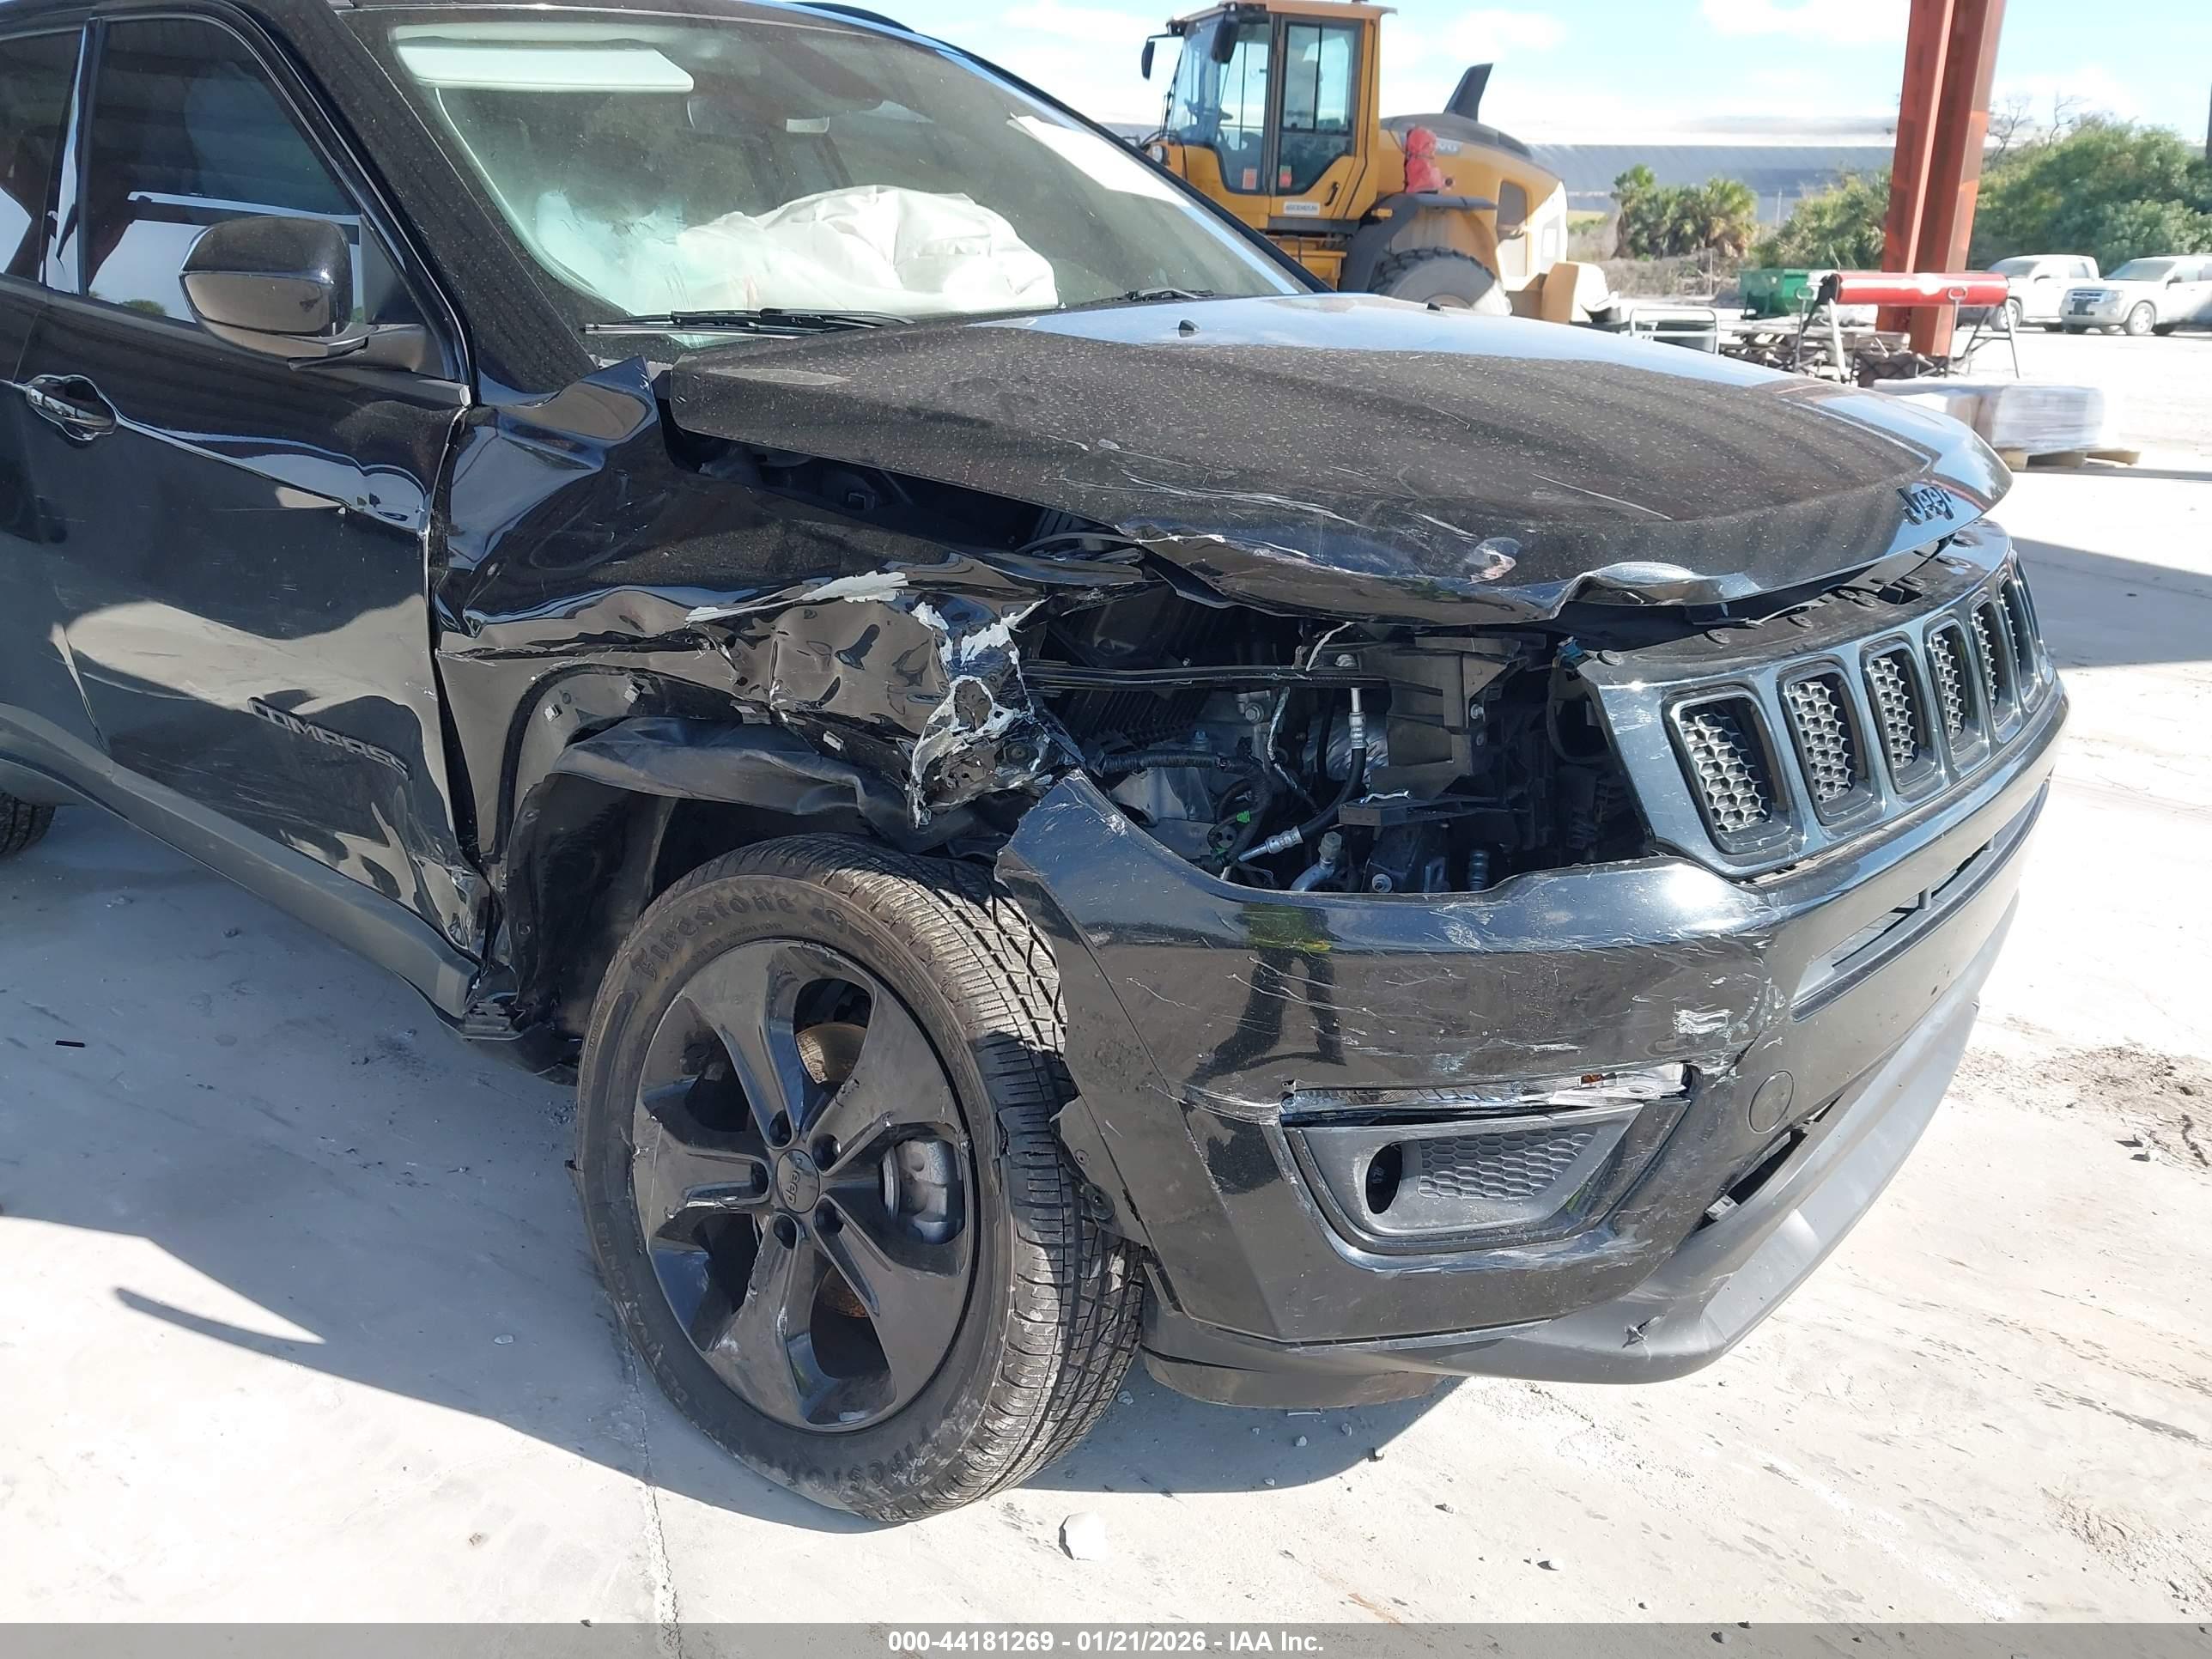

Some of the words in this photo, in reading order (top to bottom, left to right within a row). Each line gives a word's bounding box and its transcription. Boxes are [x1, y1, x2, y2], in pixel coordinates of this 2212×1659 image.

[1896, 486, 1955, 526] Jeep
[247, 696, 411, 781] COMPASS
[630, 891, 799, 981] Firestone
[784, 1157, 805, 1205] Jeep
